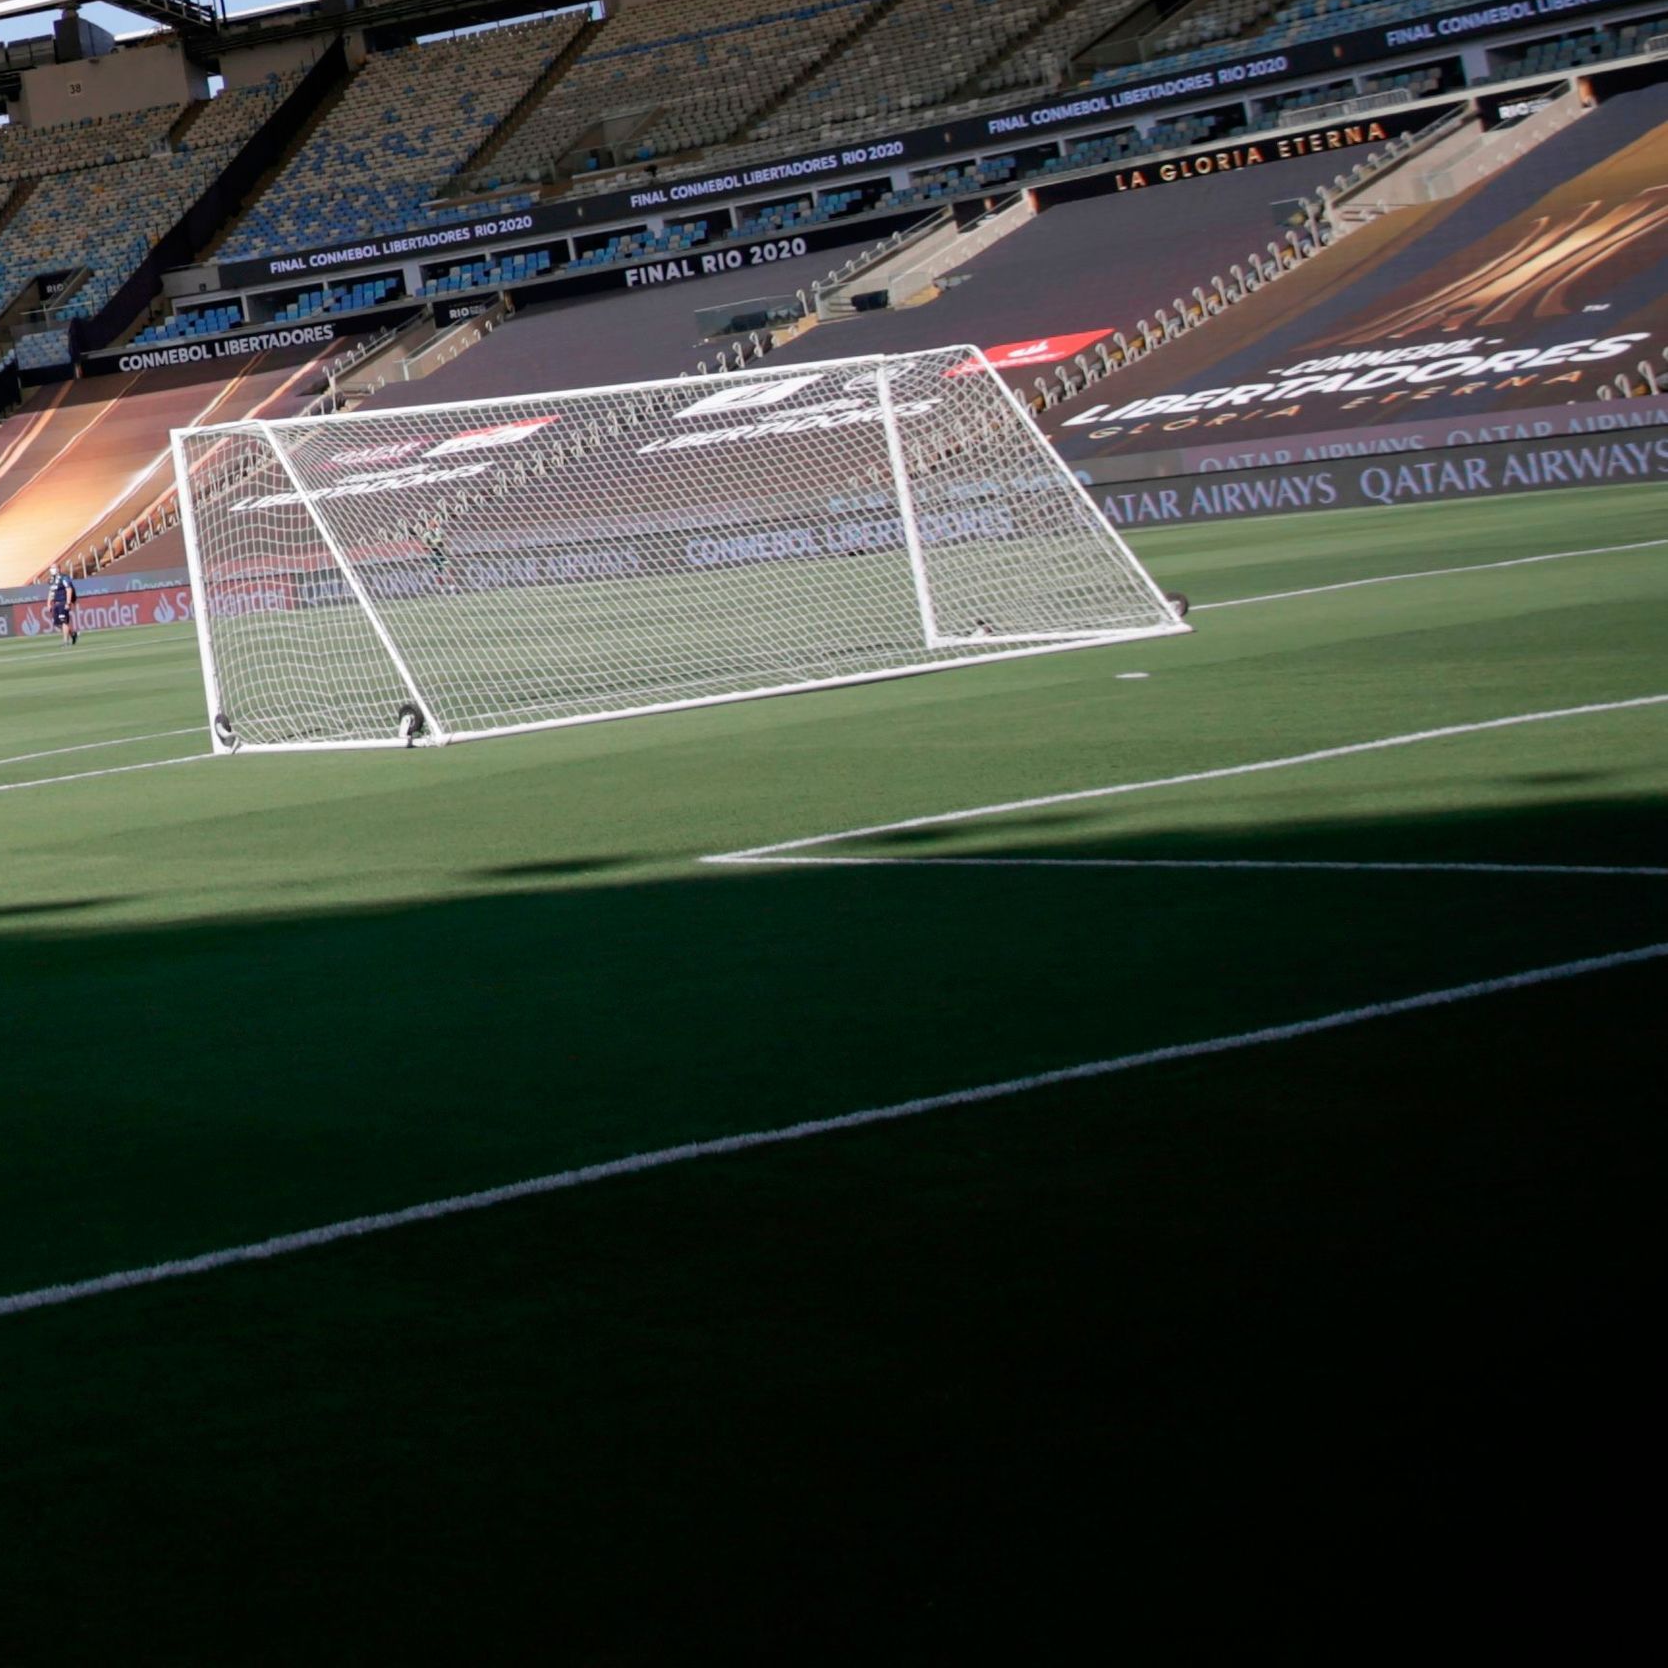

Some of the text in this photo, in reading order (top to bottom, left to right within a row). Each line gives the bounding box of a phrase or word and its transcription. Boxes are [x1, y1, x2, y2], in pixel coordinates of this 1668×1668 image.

[1386, 24, 1436, 47] FINAL
[1438, 1, 1536, 36] CONMEBOL
[69, 84, 81, 94] 38
[988, 56, 1288, 134] FINAL CONMEBOL LIBERTADORES RIO 2020
[630, 141, 904, 208] FINAL CONMEBOL LIBERTADORES RIO 2020
[1115, 121, 1387, 192] LA GLORIA ETERNA
[270, 215, 533, 274] FINAL CONMEBOL LIBERTADORES RIO 2020
[625, 237, 807, 287] FINAL RIO 2020
[449, 307, 469, 320] RIO
[118, 324, 336, 372] CONMEBOL LIBERTADORES
[1061, 332, 1651, 427] LIBERTADORES
[1340, 371, 1583, 409] ETERNA
[1100, 488, 1181, 526] ATAR
[1190, 472, 1338, 516] AIRWAYS
[1360, 457, 1491, 505] QATAR
